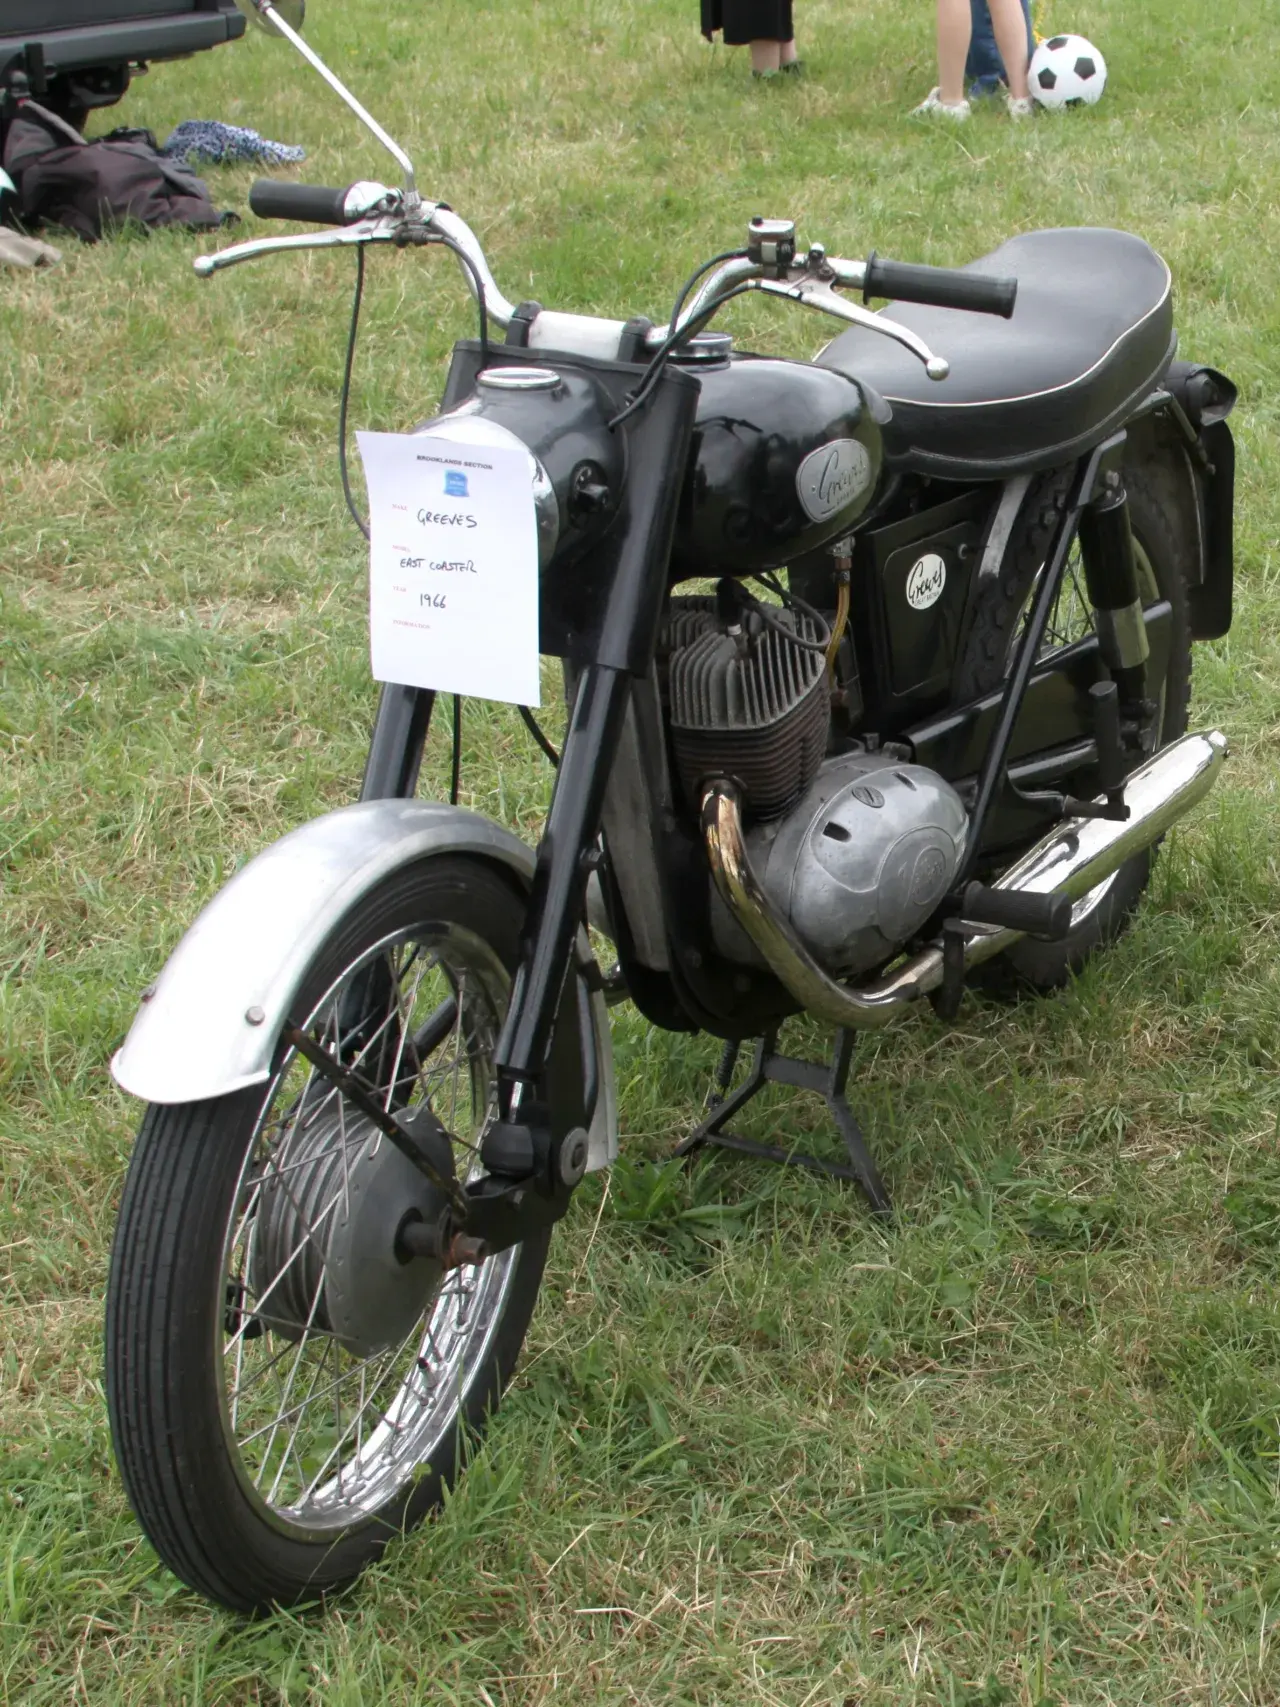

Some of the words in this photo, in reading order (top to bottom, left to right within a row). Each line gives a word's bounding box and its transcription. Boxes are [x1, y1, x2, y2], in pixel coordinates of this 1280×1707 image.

[416, 454, 462, 466] BROOKLANDS
[463, 461, 493, 470] SECTION
[417, 508, 477, 528] GREEVES
[400, 557, 426, 568] EAST
[429, 560, 477, 573] COASTER
[420, 593, 446, 608] 1966
[393, 619, 431, 629] INFORMATION
